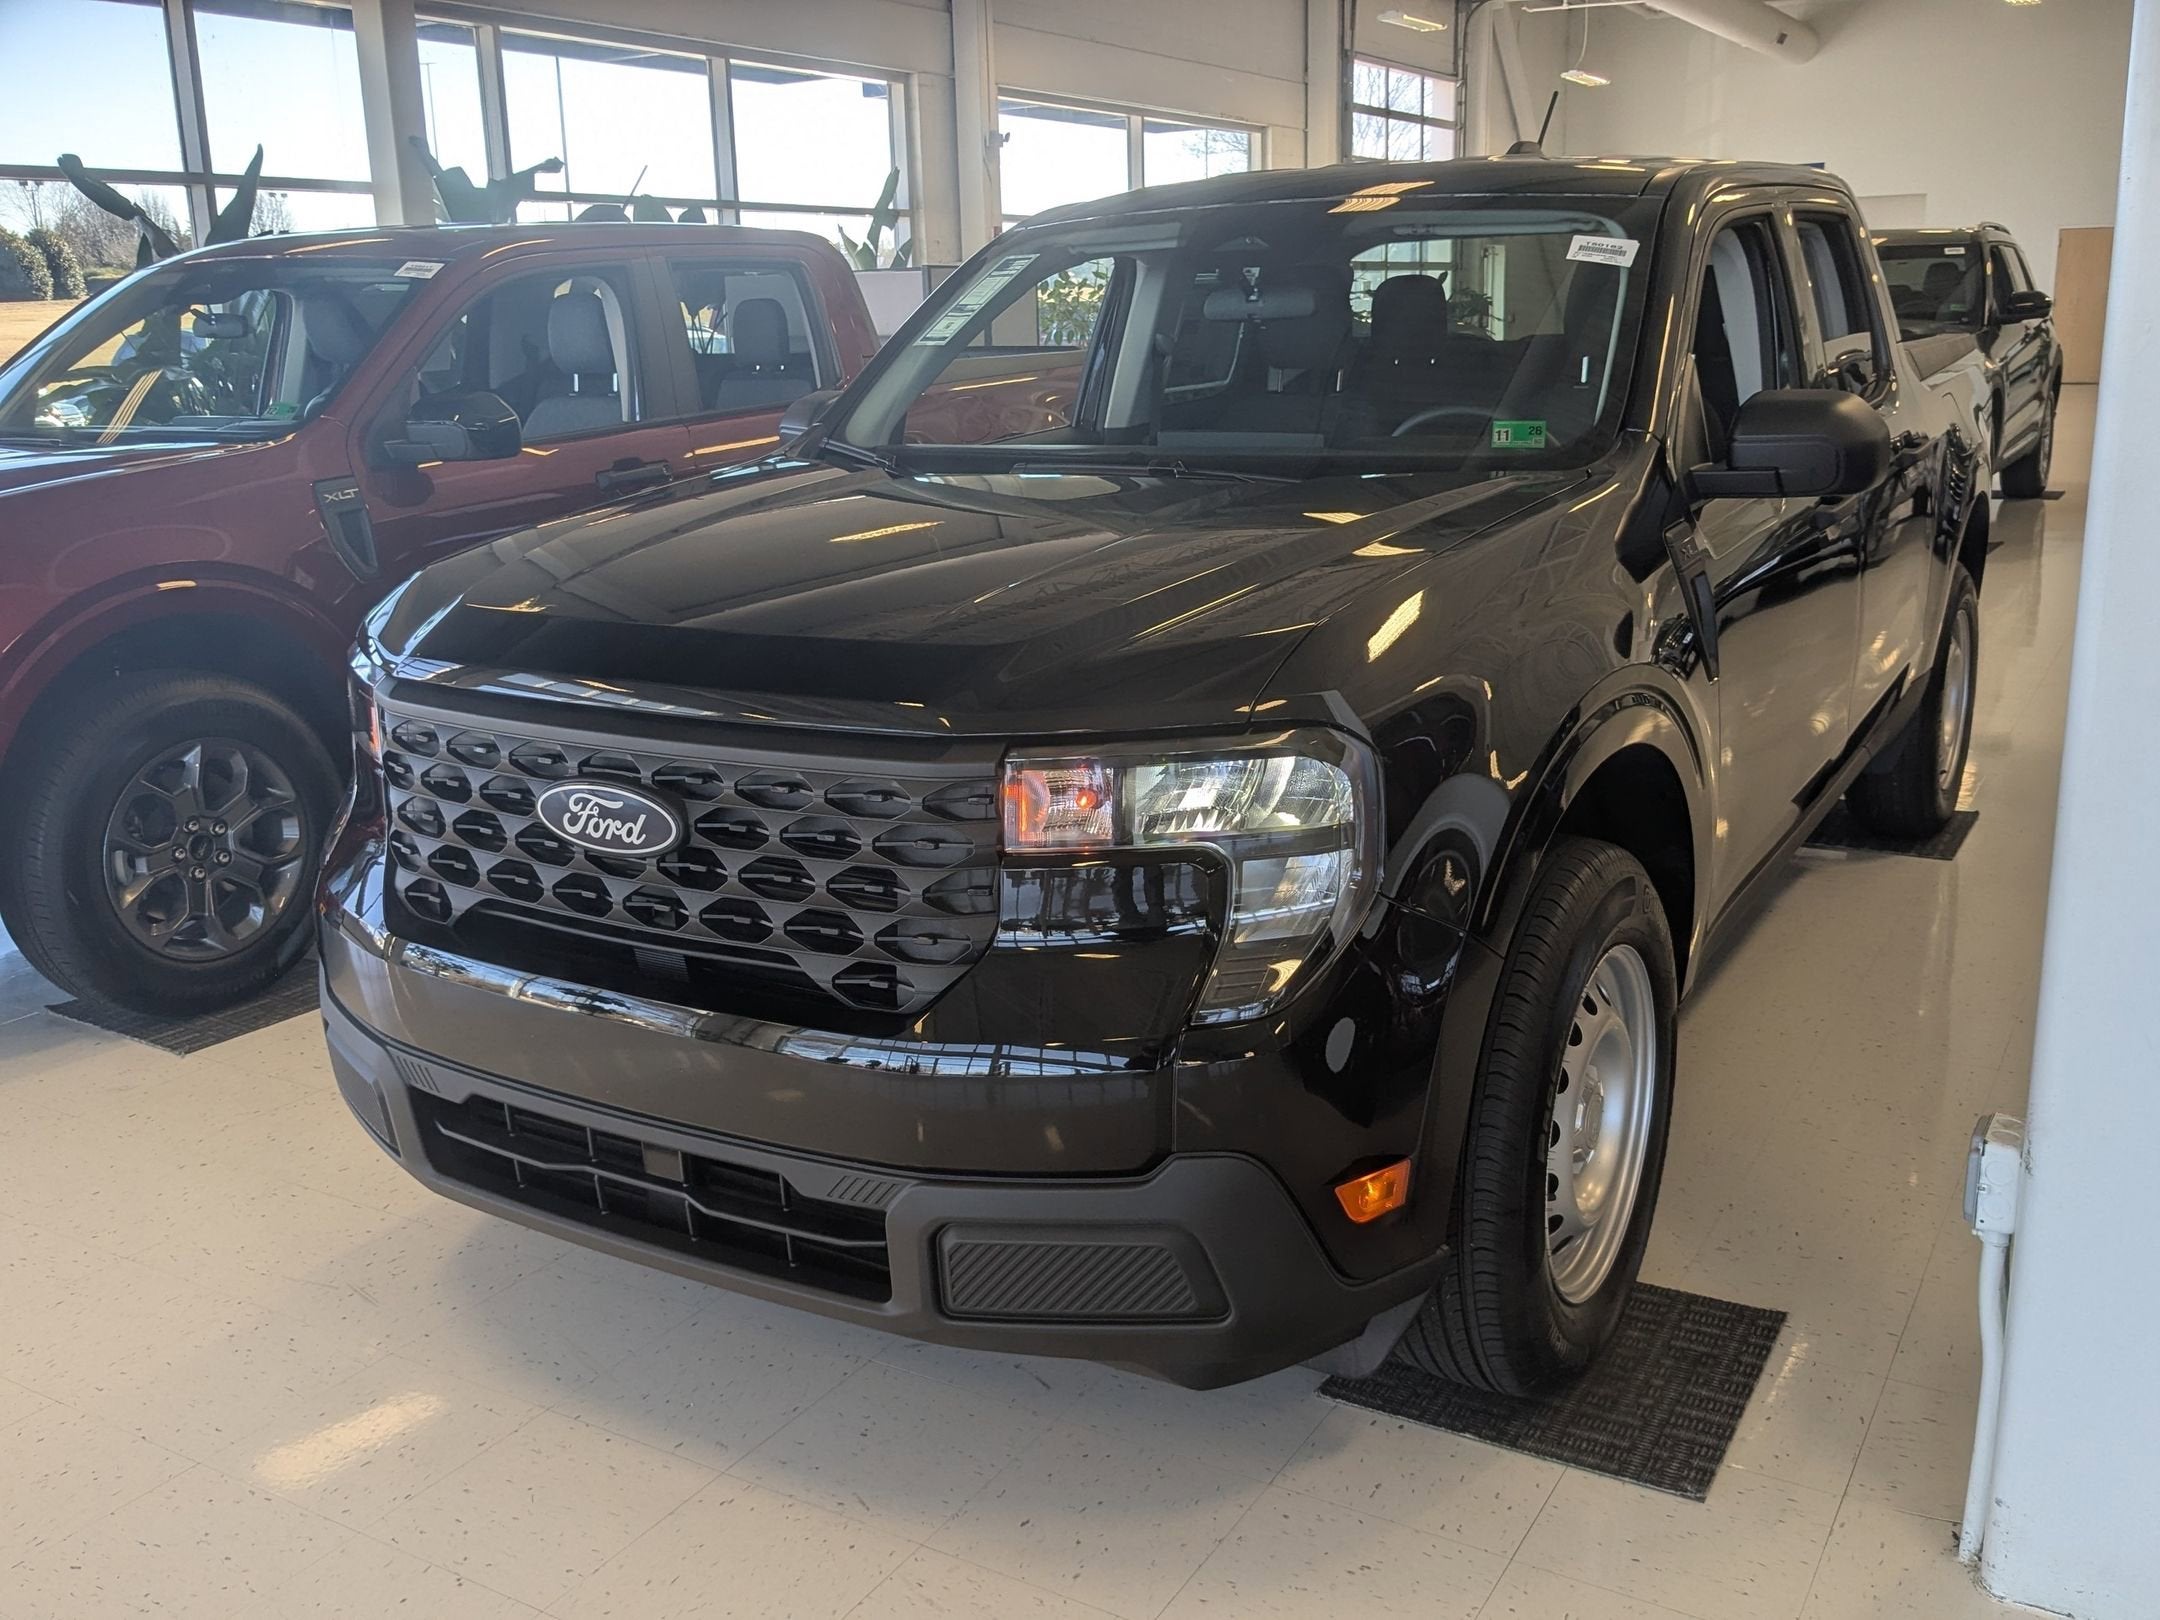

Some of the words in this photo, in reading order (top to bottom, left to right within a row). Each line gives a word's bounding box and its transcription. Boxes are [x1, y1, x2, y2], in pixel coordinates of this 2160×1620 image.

[1495, 429, 1509, 441] 11
[323, 488, 359, 503] XLT
[563, 793, 647, 845] Ford
